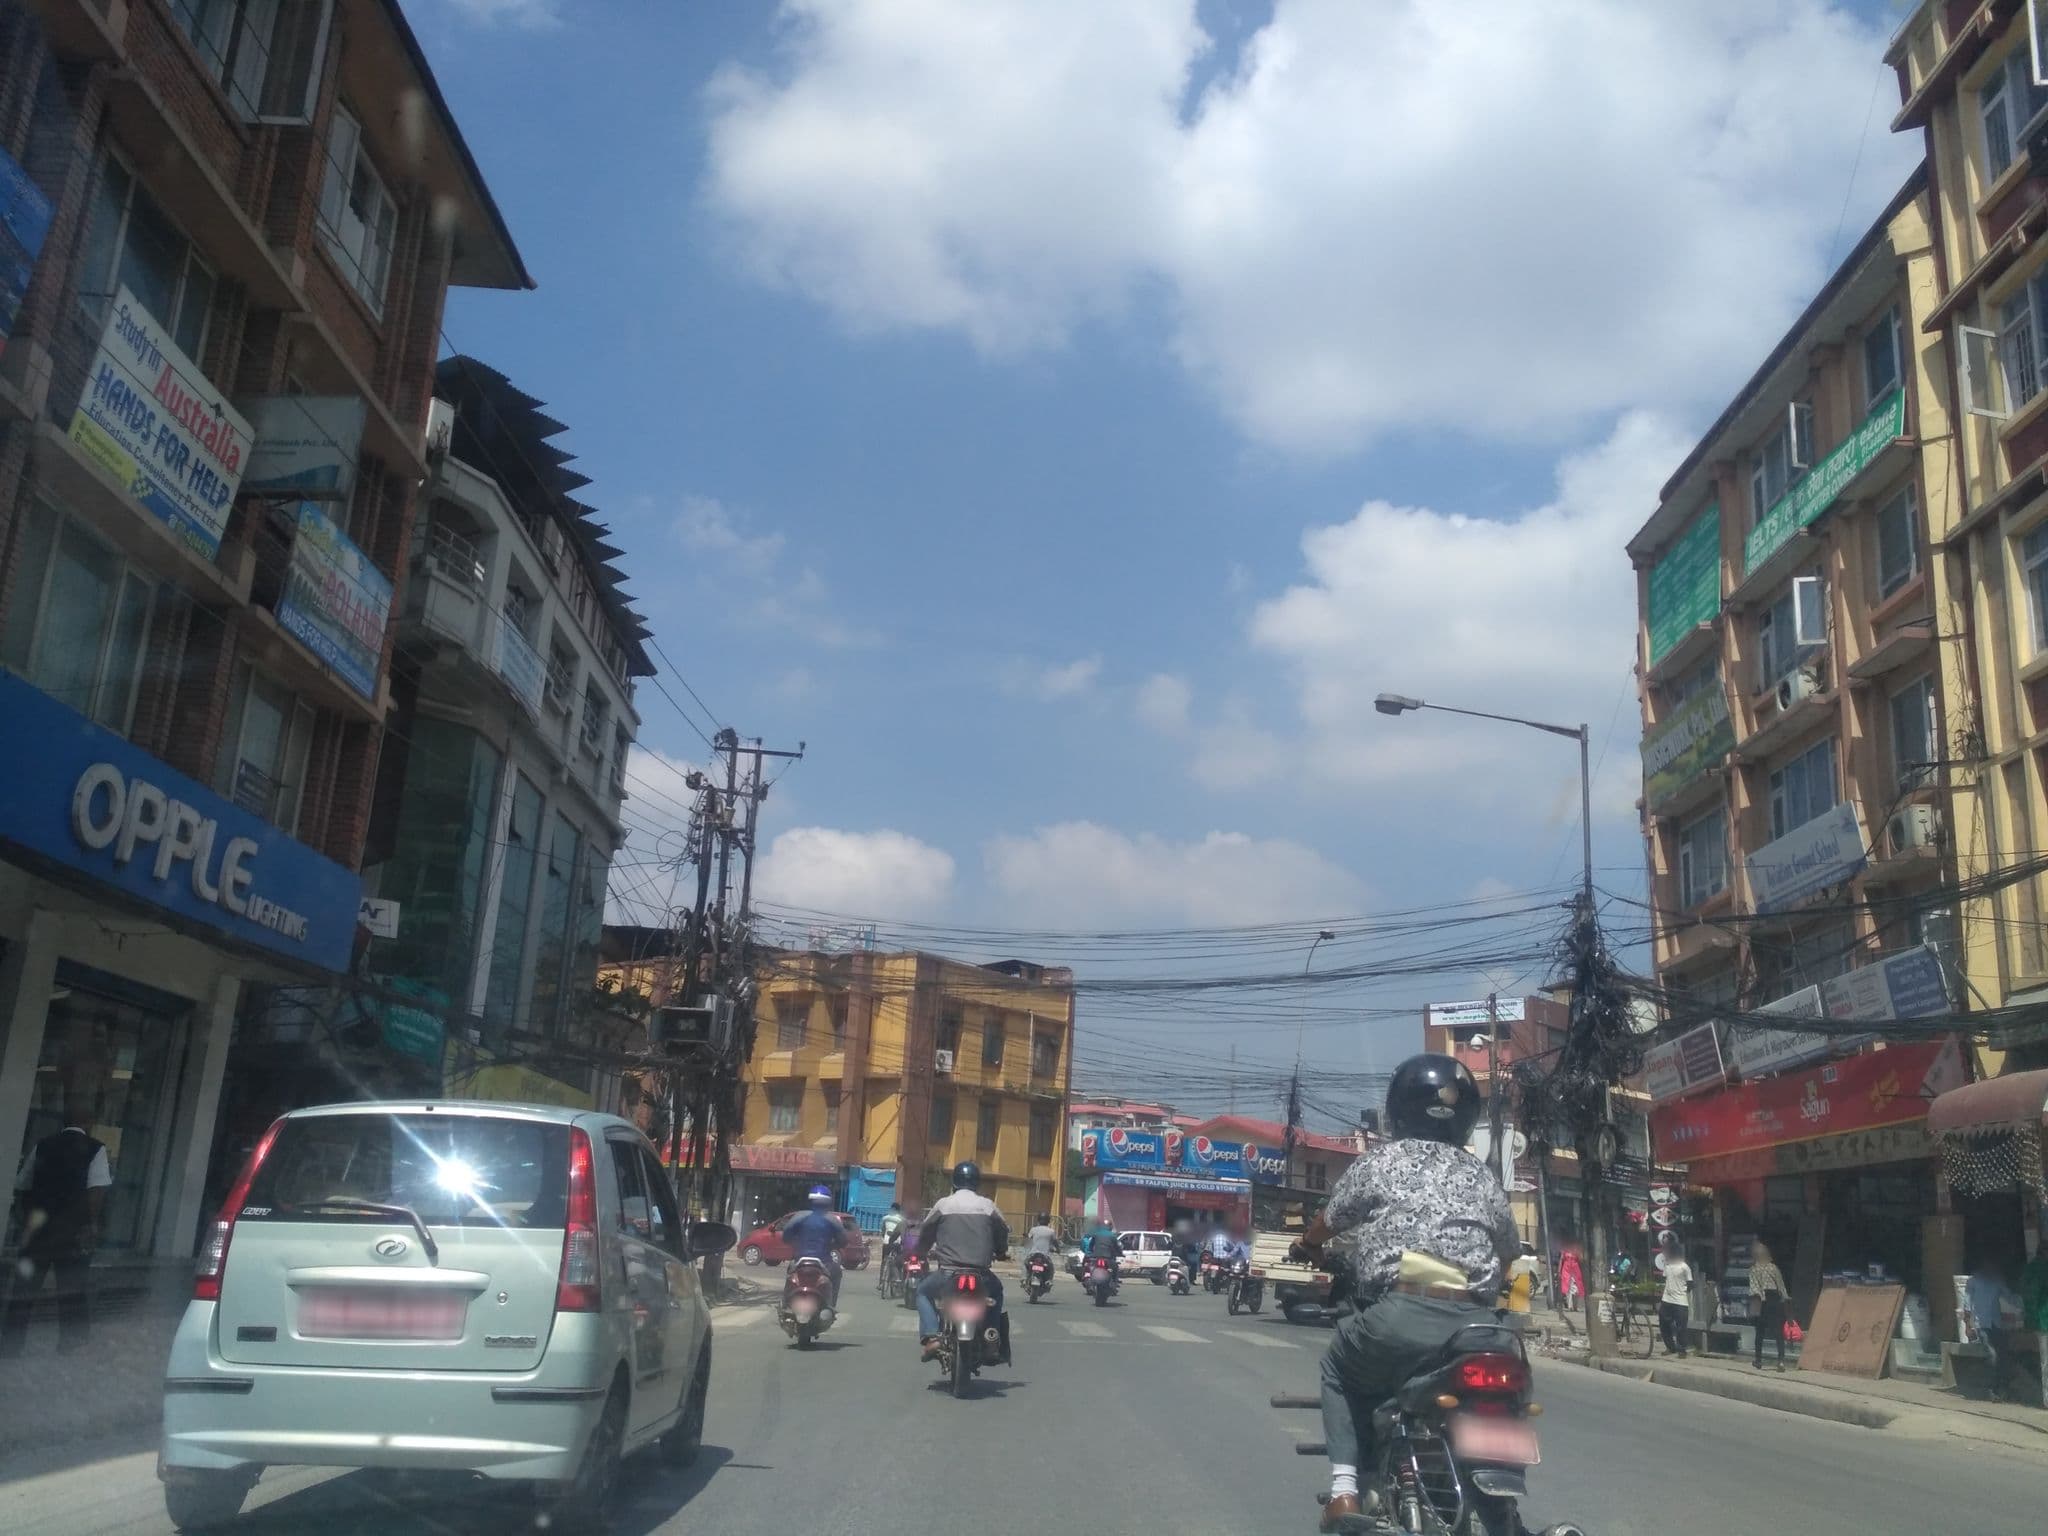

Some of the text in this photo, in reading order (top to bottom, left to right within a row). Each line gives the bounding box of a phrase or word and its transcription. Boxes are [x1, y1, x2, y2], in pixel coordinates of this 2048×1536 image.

[115, 303, 162, 375] Study in
[93, 362, 156, 445] HANDS
[153, 423, 190, 480] FOR
[187, 457, 230, 512] HELP
[153, 362, 241, 474] Australia
[72, 762, 258, 914] OPPLE
[246, 893, 309, 942] LIGHTING
[1799, 1096, 1831, 1122] Sagun
[1128, 1141, 1155, 1155] pepsi
[1213, 1147, 1239, 1162] pepsi
[1170, 1181, 1188, 1189] JUICE
[1196, 1183, 1215, 1191] COLD
[1215, 1184, 1238, 1192] STORE
